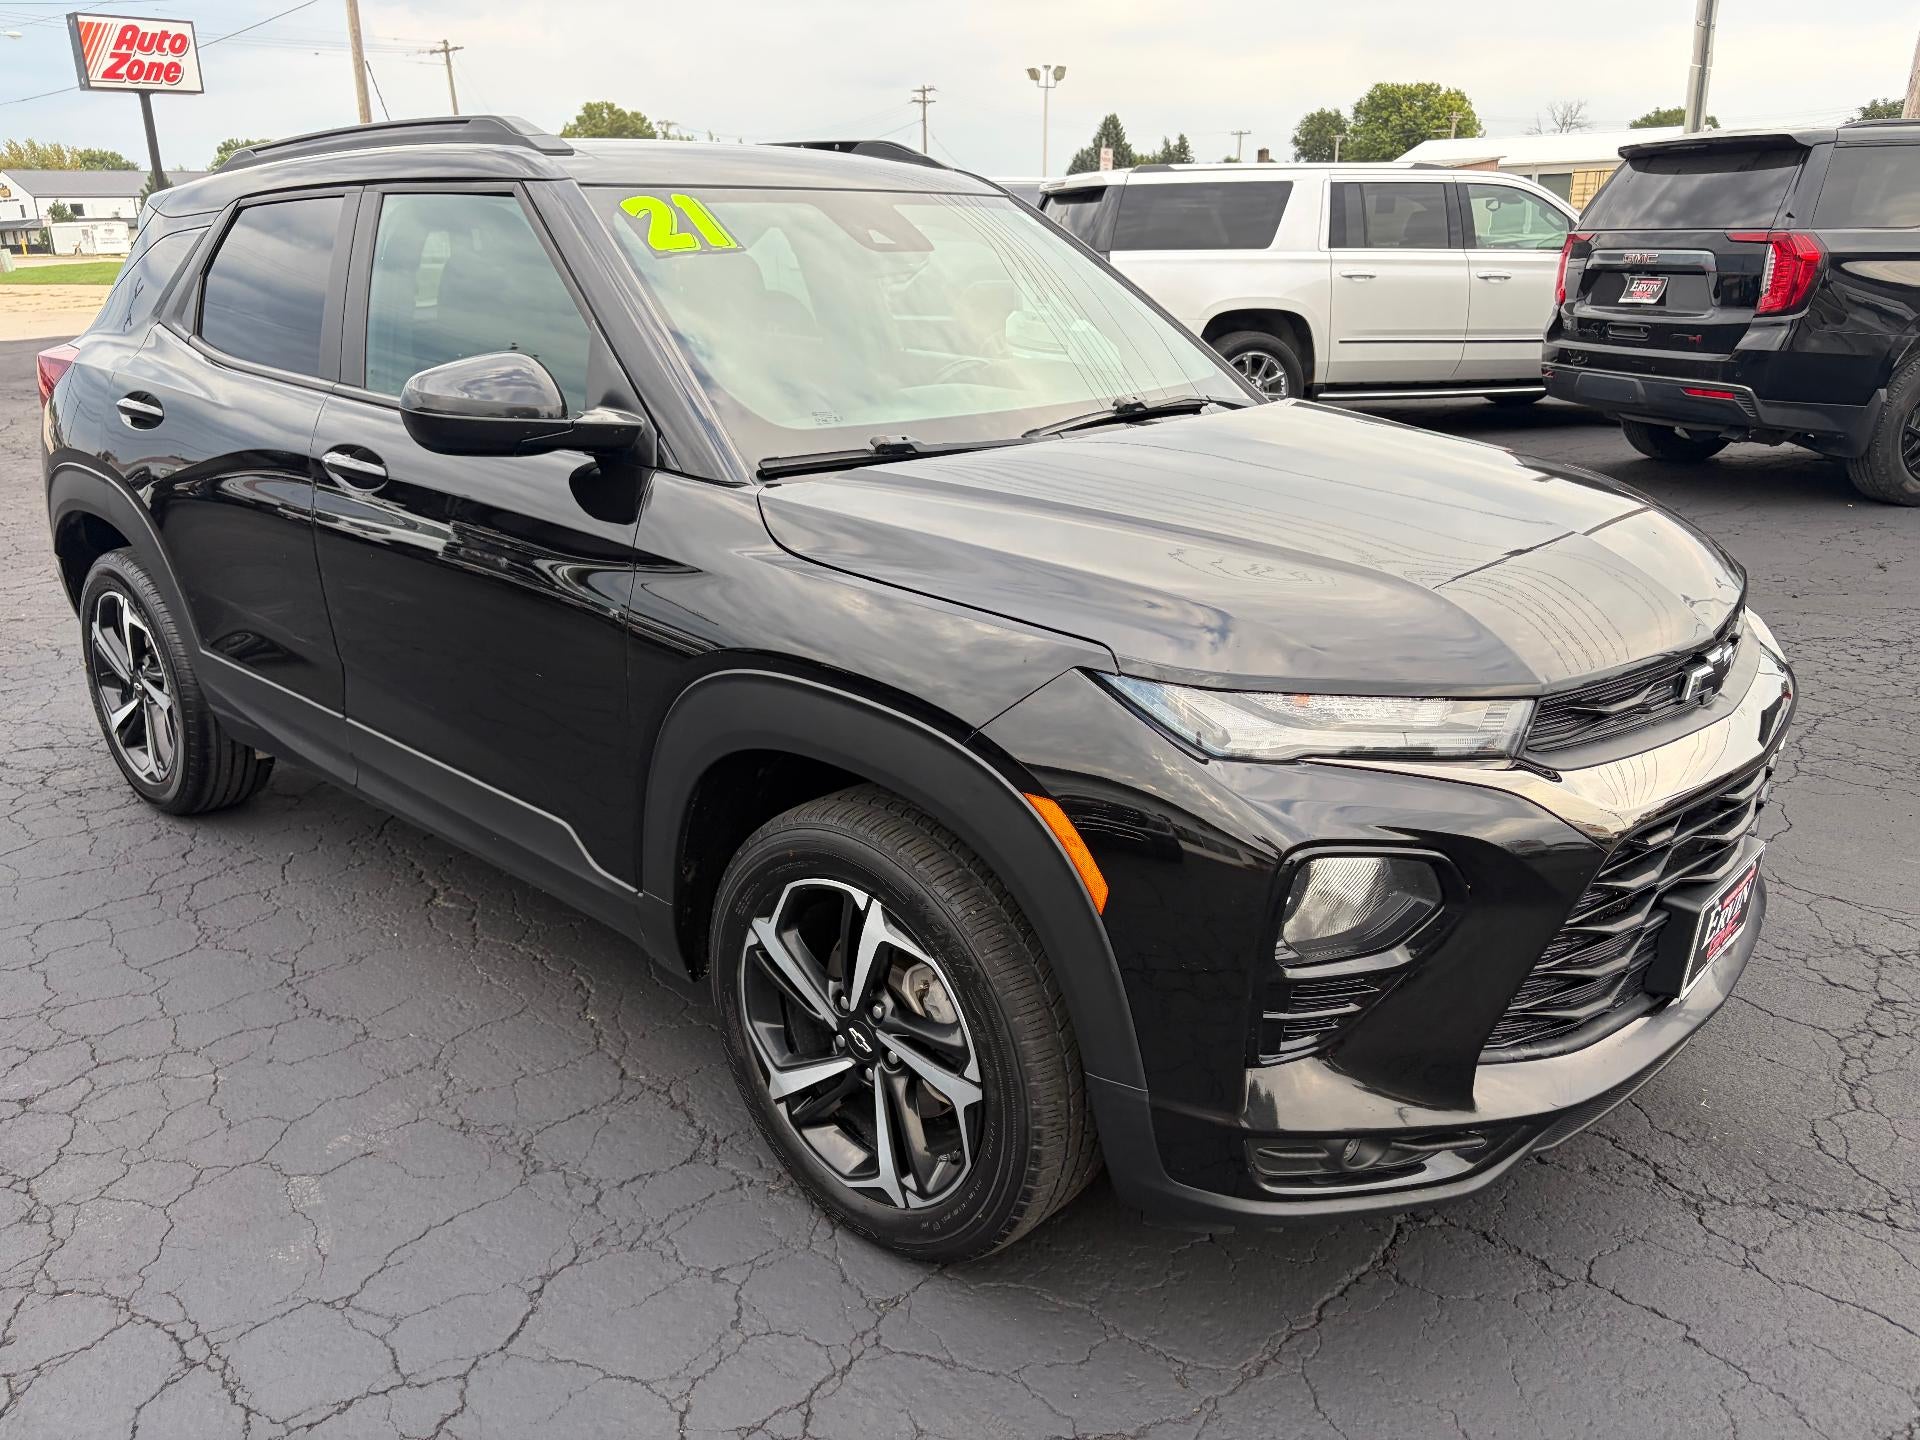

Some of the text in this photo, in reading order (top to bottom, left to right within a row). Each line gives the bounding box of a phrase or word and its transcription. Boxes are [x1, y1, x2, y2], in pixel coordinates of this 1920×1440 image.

[113, 24, 189, 56] Auto
[101, 51, 183, 84] Zone
[620, 193, 737, 252] 21
[1623, 253, 1659, 264] GMC
[1700, 876, 1754, 951] ERVIN
